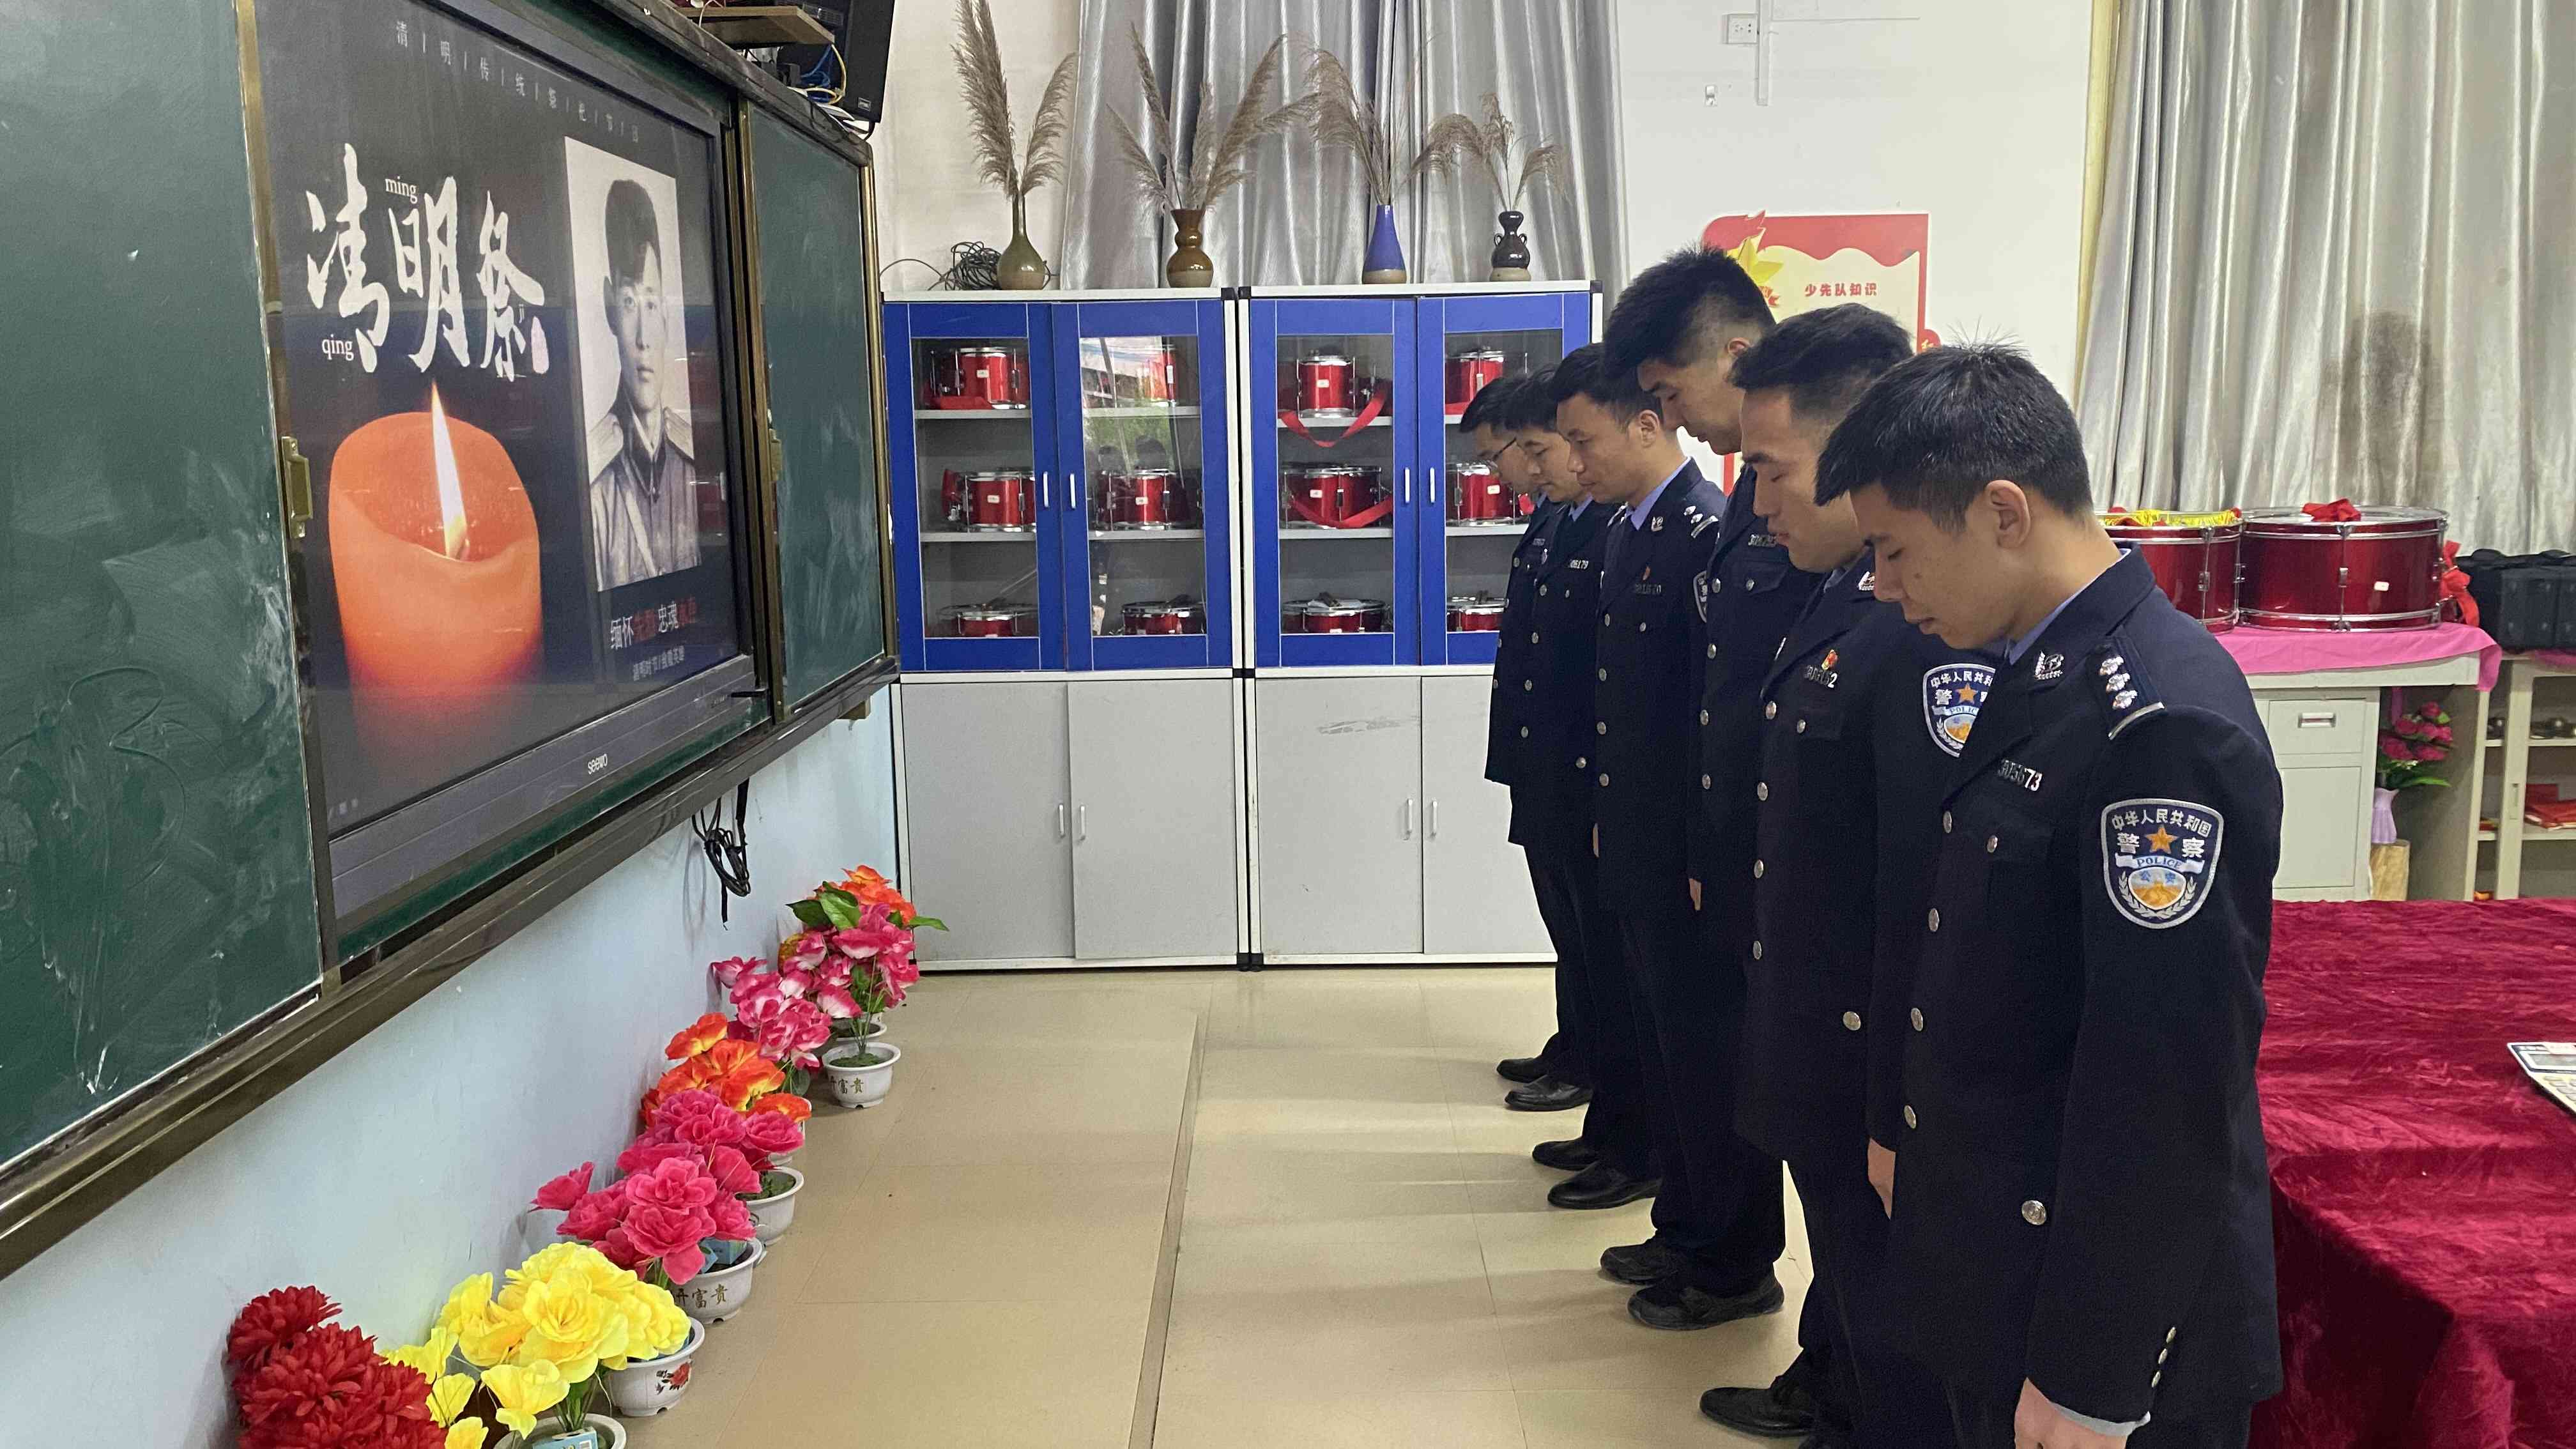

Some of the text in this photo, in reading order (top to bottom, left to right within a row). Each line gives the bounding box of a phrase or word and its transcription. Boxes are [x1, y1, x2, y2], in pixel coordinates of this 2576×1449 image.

[385, 176, 418, 204] ming
[305, 142, 546, 382] 清明祭
[1804, 282, 1878, 297] 少先队知识
[321, 334, 355, 361] qing
[587, 753, 608, 775] seewo
[2111, 808, 2212, 838] 中华人民共和国
[2136, 855, 2182, 870] POLICE
[670, 1284, 728, 1309] 开富贵
